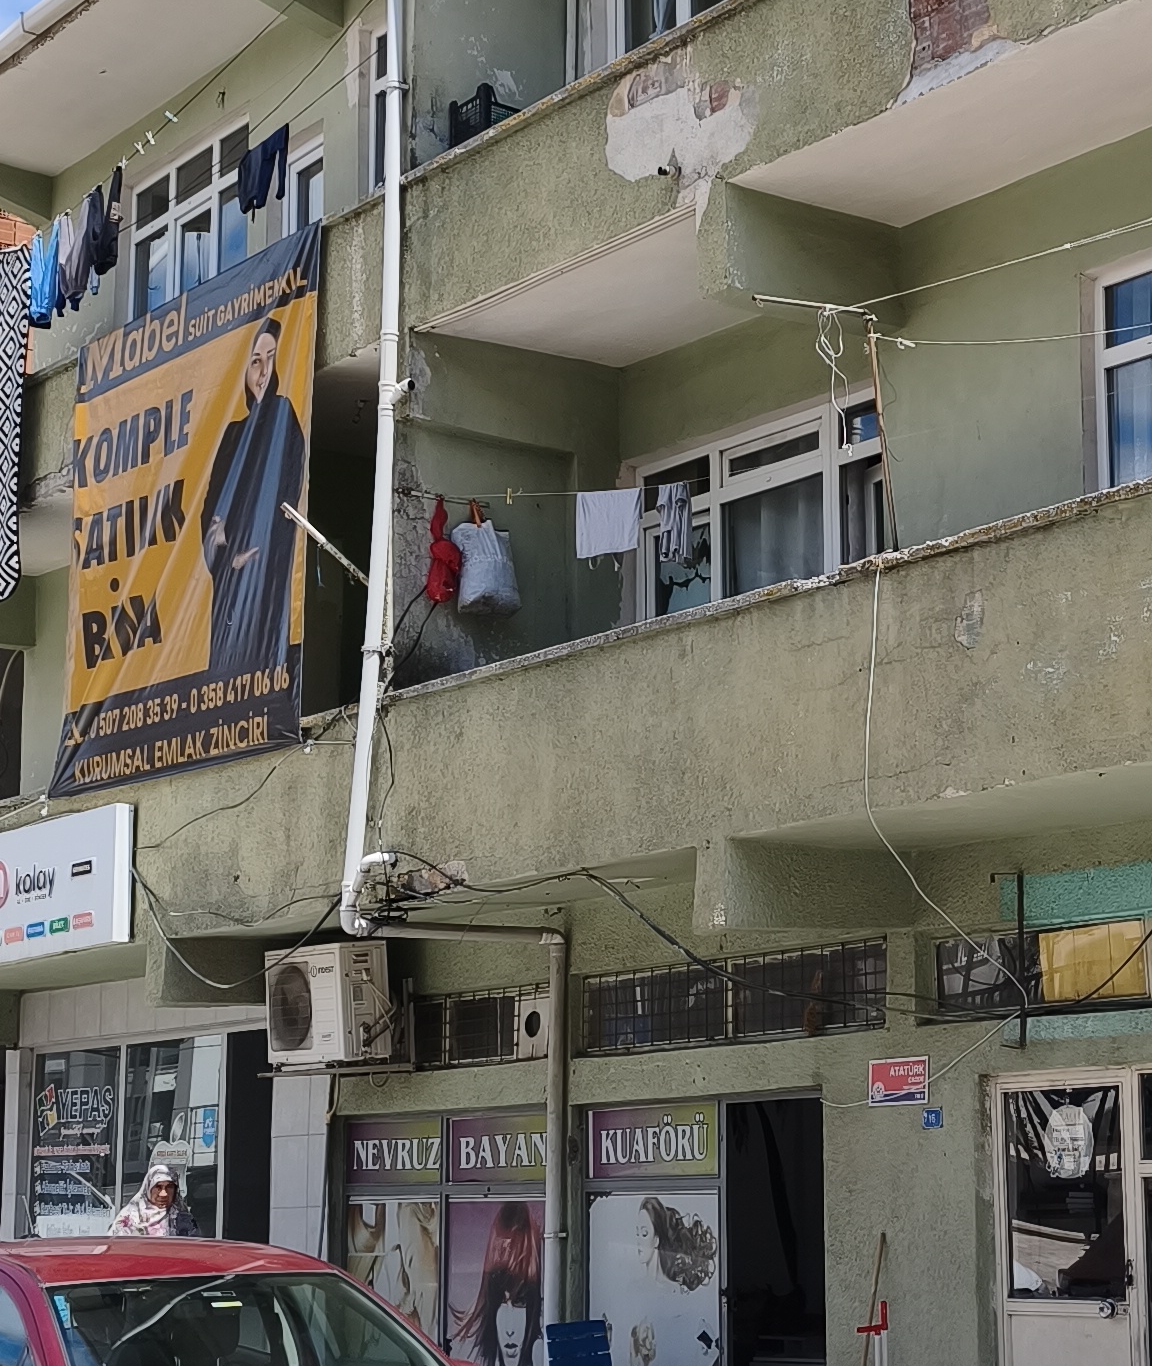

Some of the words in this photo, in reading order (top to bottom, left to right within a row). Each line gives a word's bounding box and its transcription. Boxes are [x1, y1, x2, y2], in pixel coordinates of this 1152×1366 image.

[73, 389, 193, 488] KOMPLE
[99, 709, 119, 737] 507
[121, 702, 144, 731] 208
[146, 698, 160, 725] 35
[163, 693, 179, 721] 39
[190, 689, 198, 714] 0
[200, 681, 223, 710] 358
[226, 673, 250, 704] 417
[254, 669, 270, 696] 06
[273, 663, 290, 691] 06
[74, 753, 151, 784] KURUMSAL
[154, 729, 206, 769] EMLAK
[209, 708, 268, 755] ZİNCİRİ
[15, 864, 56, 898] kolay
[889, 1063, 925, 1077] ATATÜRK
[58, 1086, 113, 1125] YEPAŞ
[353, 1137, 441, 1171] NEVRUZ
[459, 1133, 547, 1169] BAYAN
[600, 1113, 709, 1165] KUAFÖRÜ
